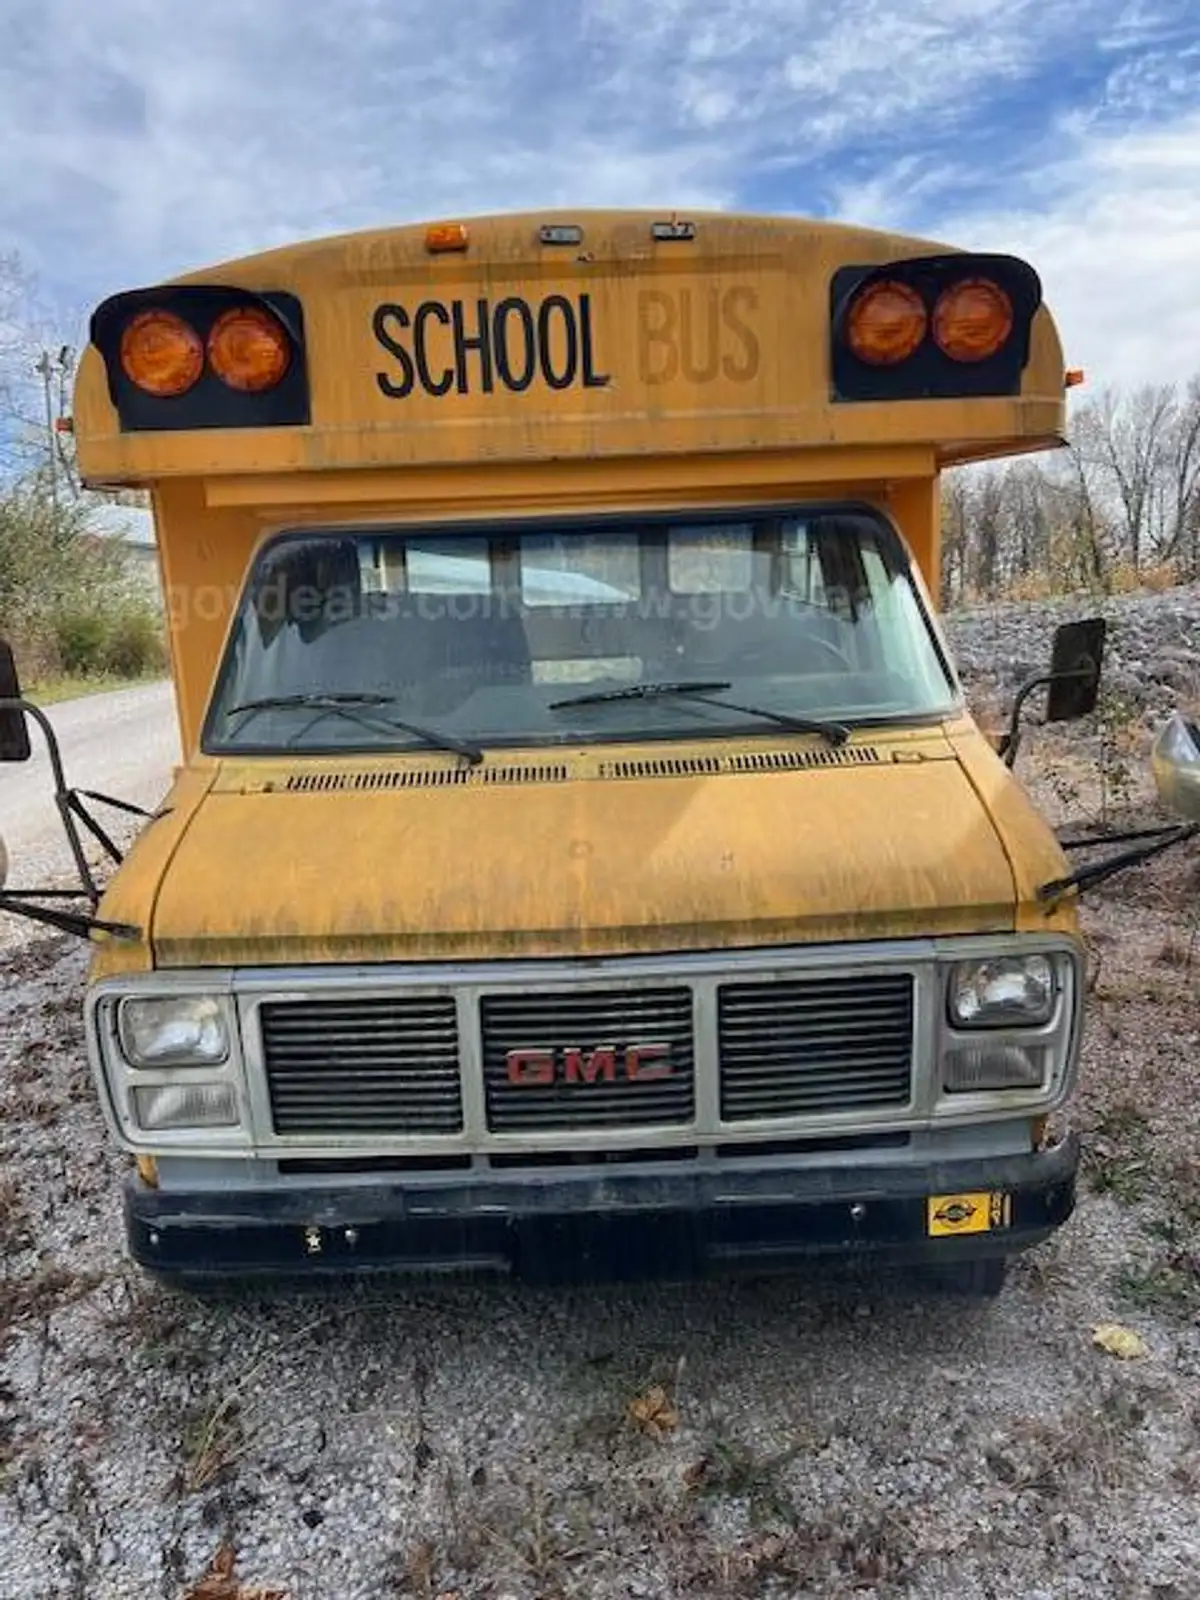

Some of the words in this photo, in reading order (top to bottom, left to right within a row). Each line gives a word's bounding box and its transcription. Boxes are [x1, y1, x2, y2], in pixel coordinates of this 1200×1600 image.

[372, 294, 611, 399] SCHOOL
[637, 285, 761, 386] BUS
[506, 1043, 672, 1083] GMC
